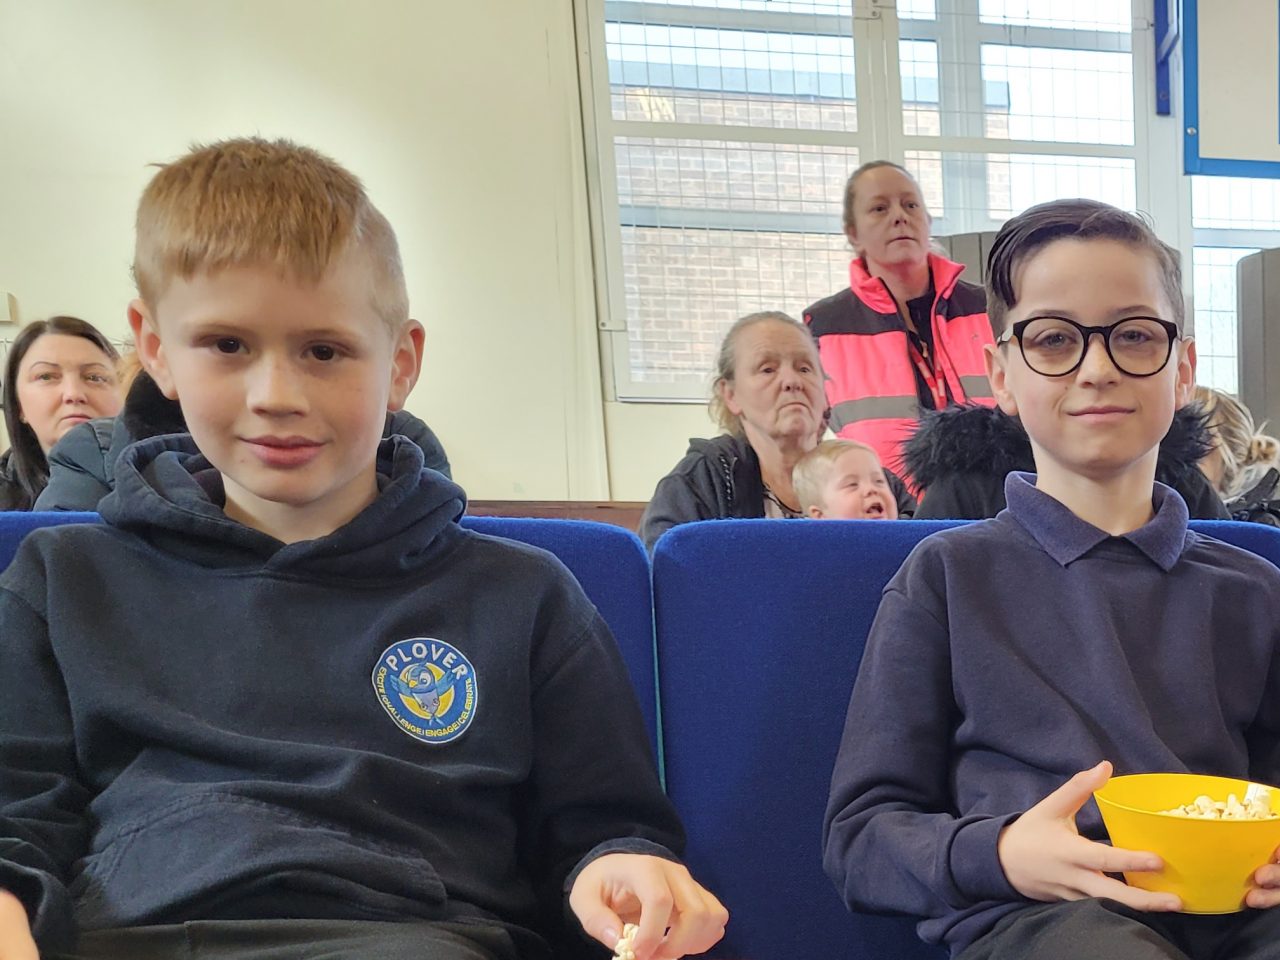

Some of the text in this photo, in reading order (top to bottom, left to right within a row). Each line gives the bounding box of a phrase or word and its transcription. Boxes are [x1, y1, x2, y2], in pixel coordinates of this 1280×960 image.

[385, 642, 468, 679] PLOVER
[376, 666, 387, 694] EXCITE
[425, 721, 460, 736] ENGAGE
